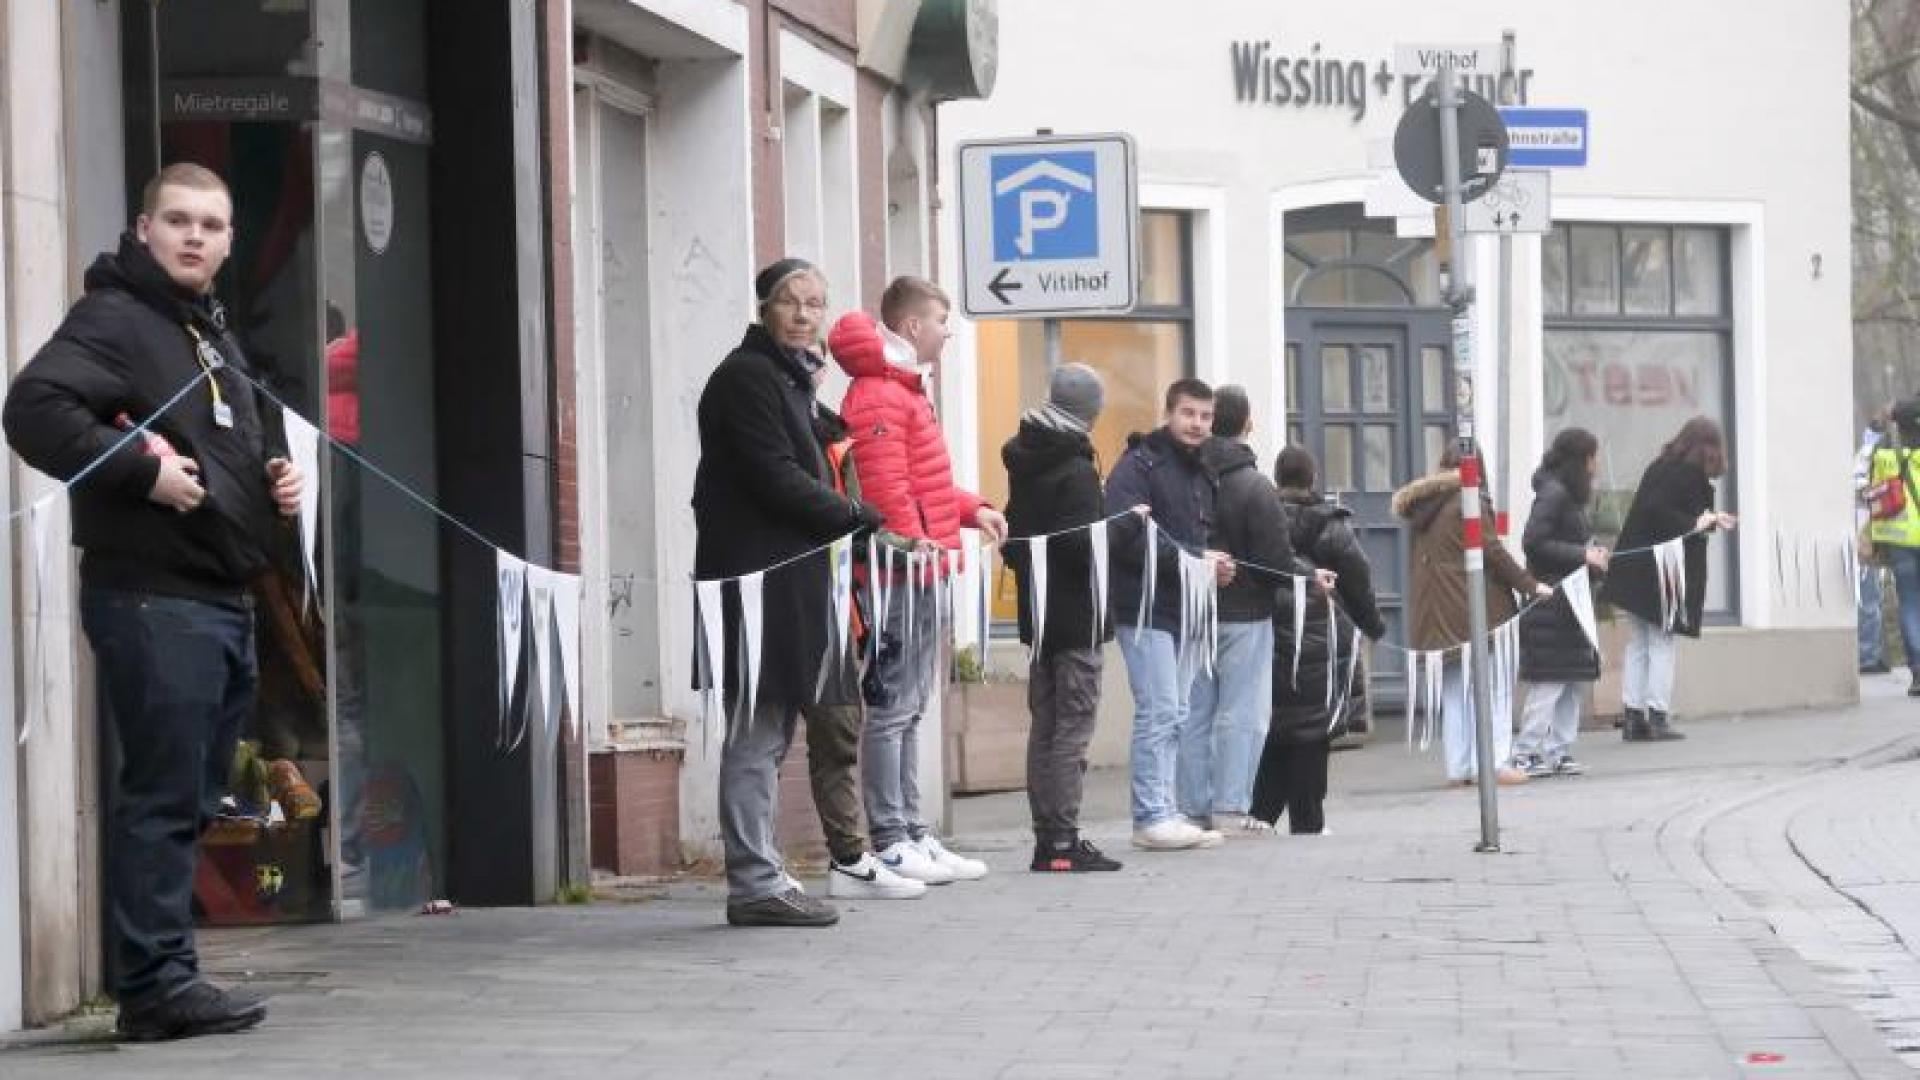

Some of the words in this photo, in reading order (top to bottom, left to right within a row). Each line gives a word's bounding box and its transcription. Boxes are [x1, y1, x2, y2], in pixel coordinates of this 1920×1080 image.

[1418, 49, 1478, 69] Vitihof
[1230, 40, 1367, 121] Wissing
[173, 91, 289, 117] Mietregale
[1508, 131, 1578, 145] hnstraße
[1038, 271, 1111, 293] Vitihof
